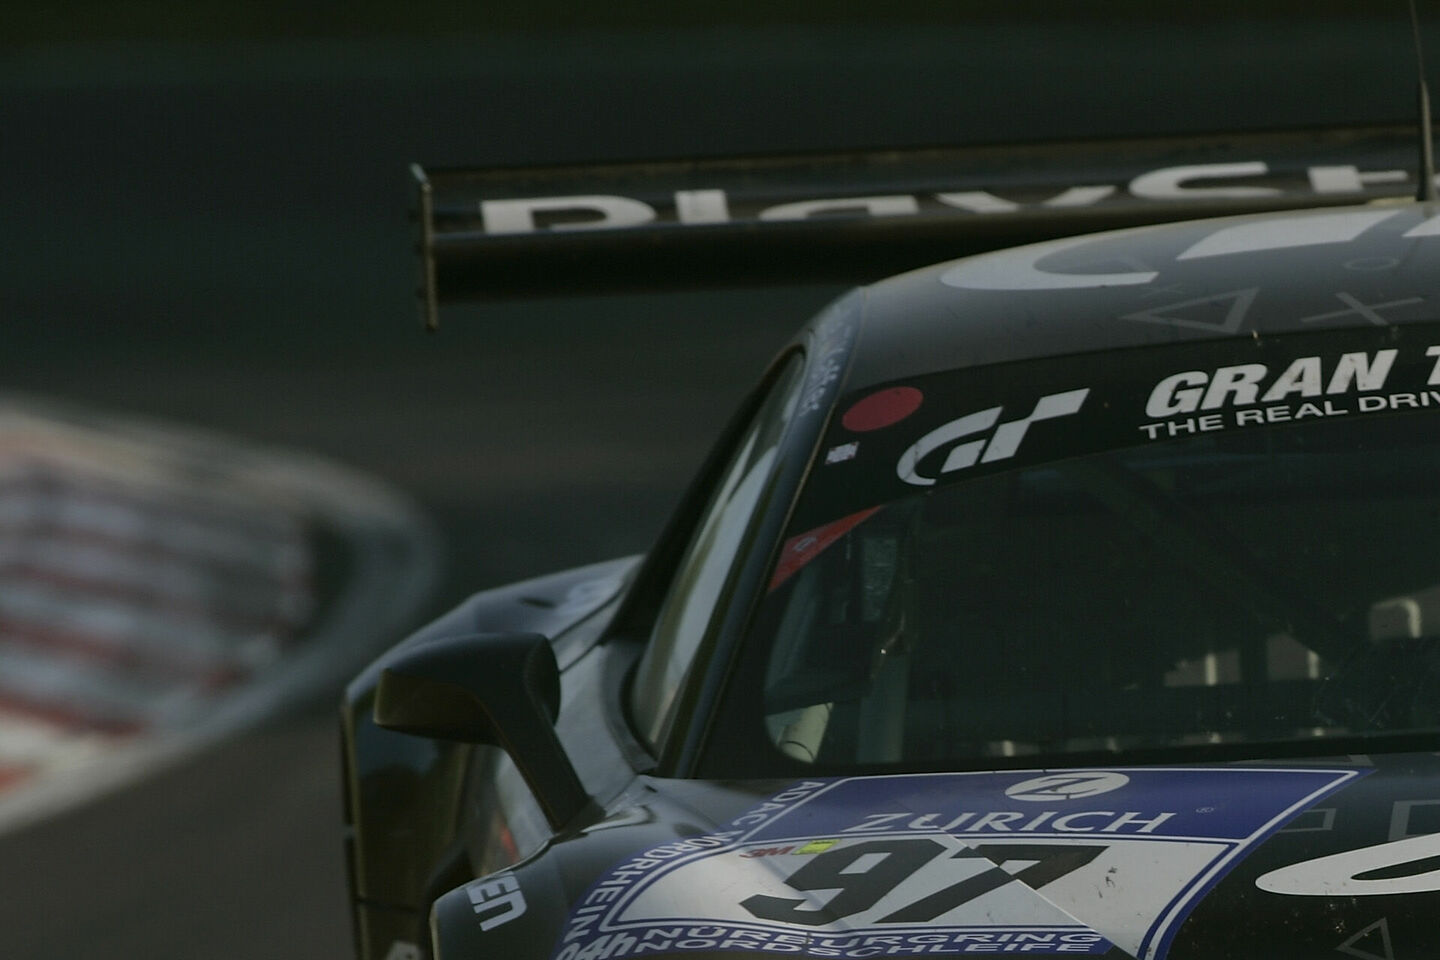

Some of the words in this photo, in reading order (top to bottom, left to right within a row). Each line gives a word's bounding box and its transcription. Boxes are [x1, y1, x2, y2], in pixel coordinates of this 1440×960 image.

[1144, 348, 1399, 419] GRAN
[1138, 413, 1225, 440] THE
[1235, 400, 1350, 427] REAL
[731, 780, 827, 828] ADAC
[838, 810, 1178, 834] ZURICH
[466, 872, 529, 932] EN
[562, 829, 744, 943] NORDRHEIN
[739, 838, 1111, 927] 97
[634, 938, 1095, 958] NORDSCHLEIFE
[642, 925, 1103, 949] NÜRBURGRING
